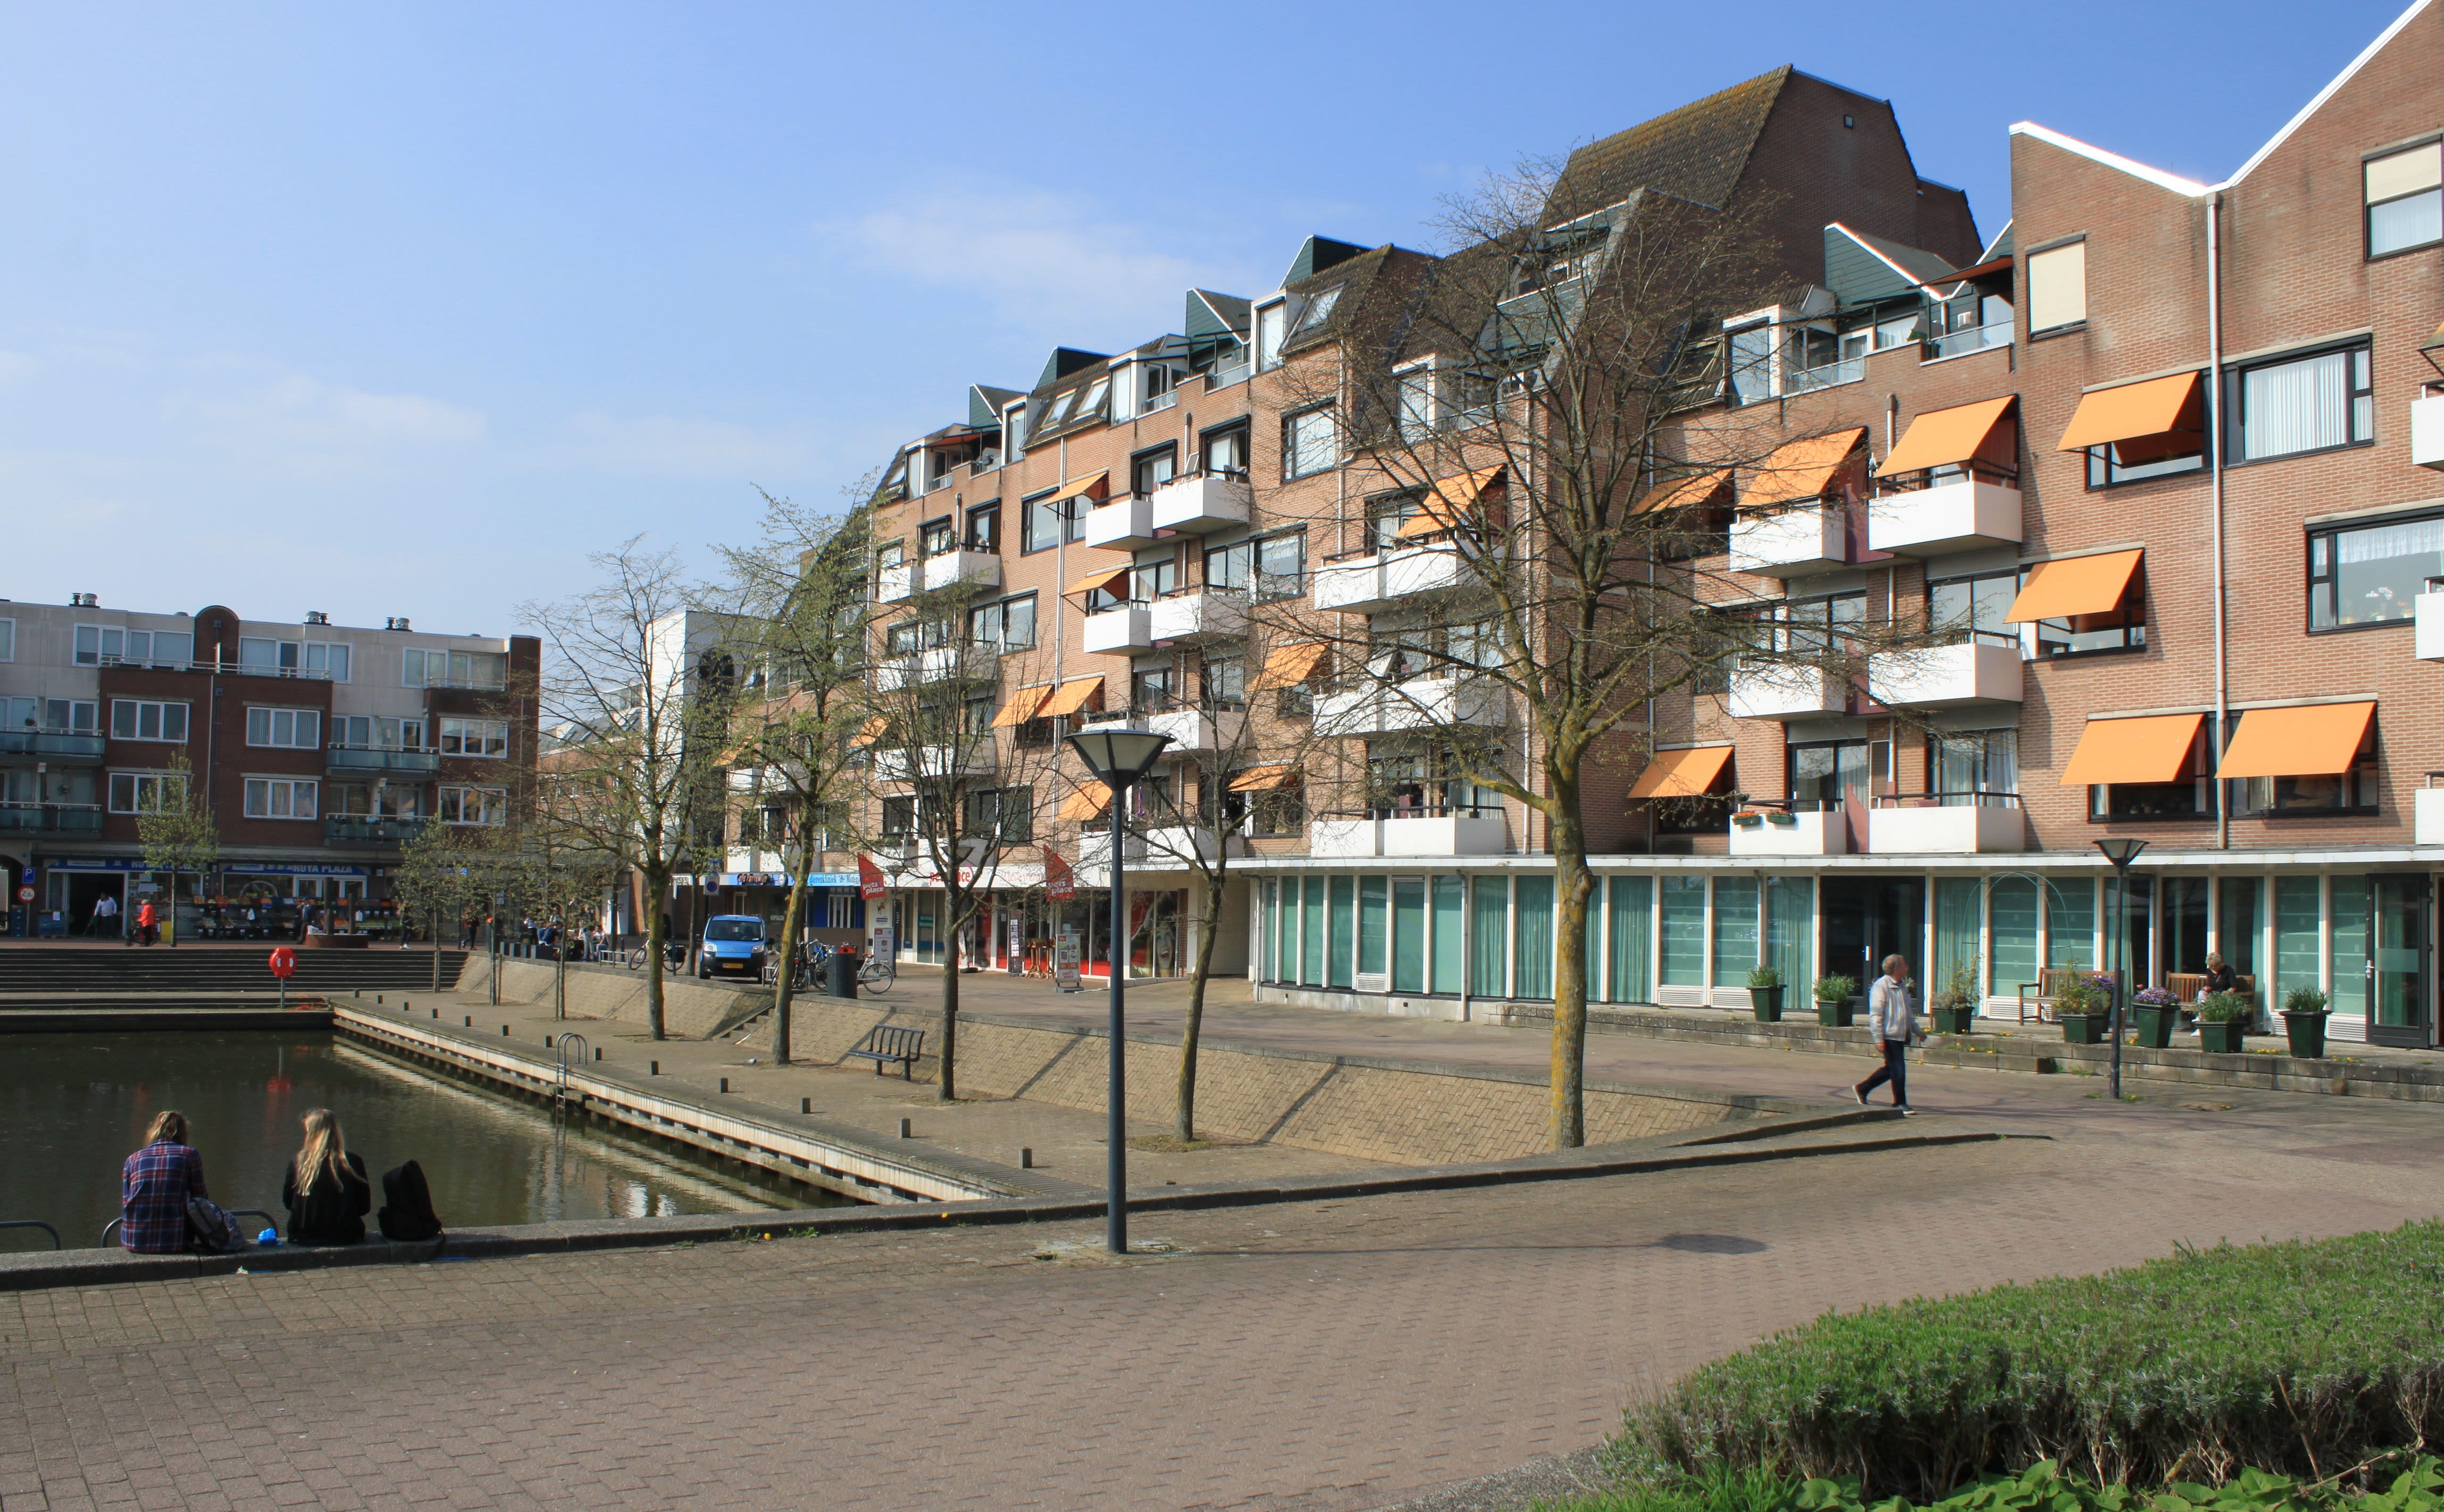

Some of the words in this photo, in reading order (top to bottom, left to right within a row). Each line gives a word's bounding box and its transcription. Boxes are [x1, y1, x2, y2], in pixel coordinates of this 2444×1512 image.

[863, 882, 878, 890] pets
[866, 886, 884, 895] place
[1051, 887, 1073, 896] place
